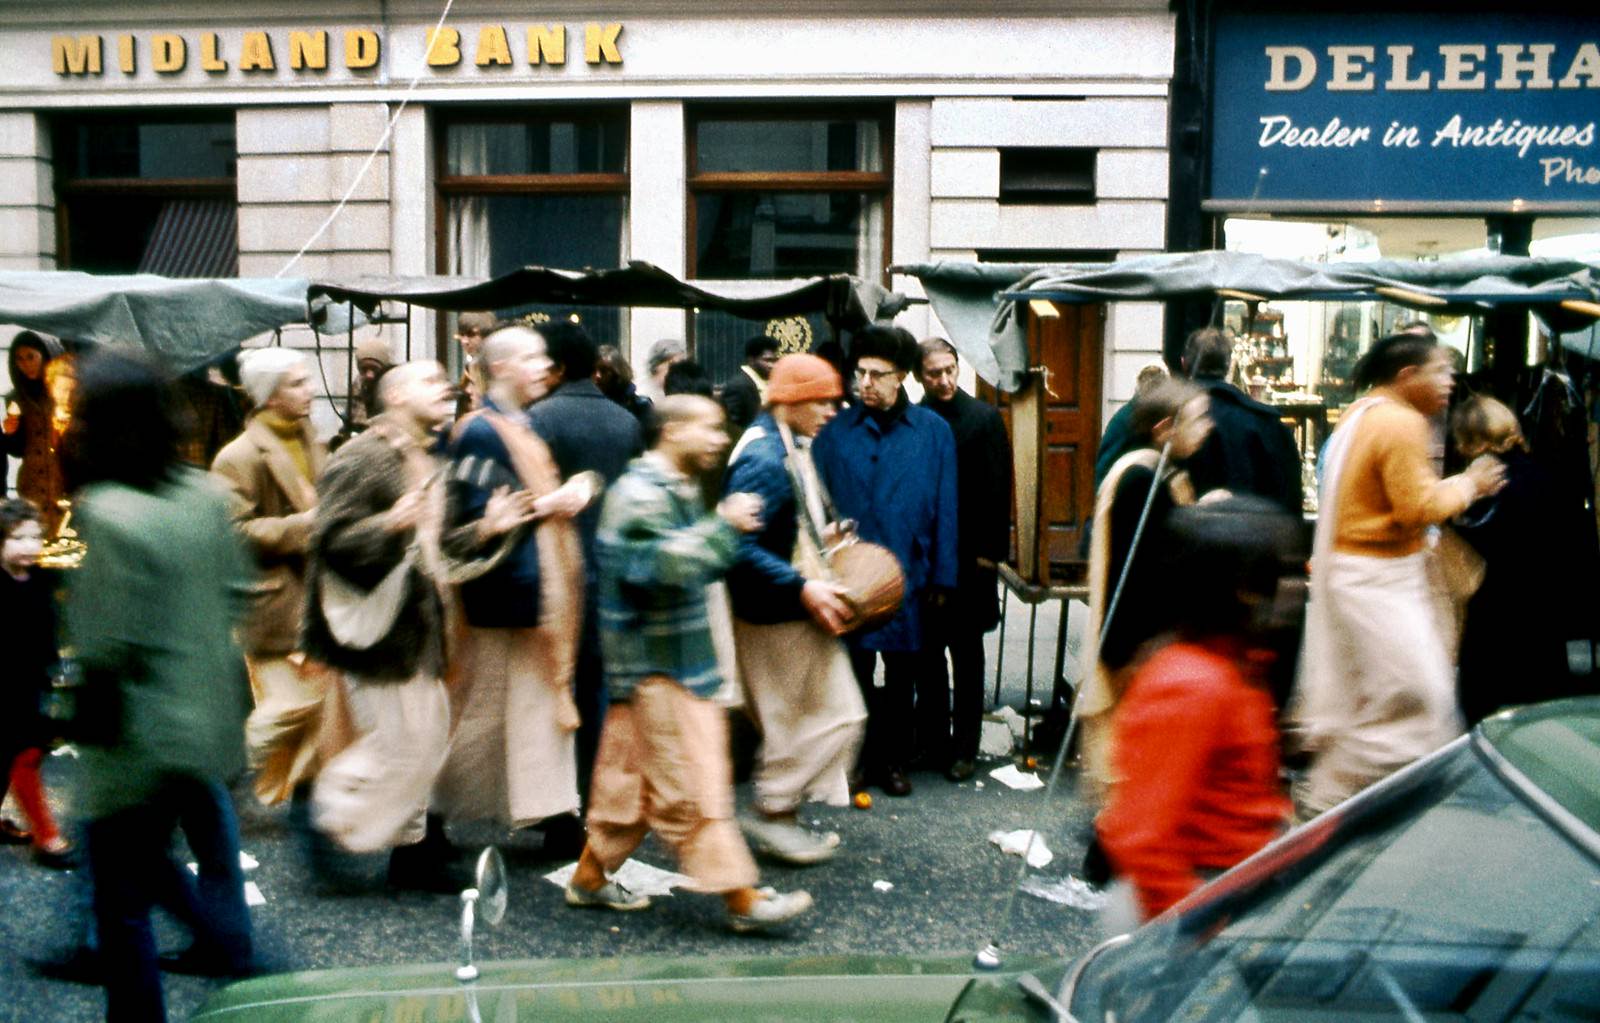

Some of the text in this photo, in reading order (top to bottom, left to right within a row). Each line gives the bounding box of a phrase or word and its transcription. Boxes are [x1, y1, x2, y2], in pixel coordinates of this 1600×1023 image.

[52, 22, 626, 76] MIDLAND BANK
[1265, 43, 1600, 91] DELEHA
[1259, 114, 1594, 157] Dealer in Antiques
